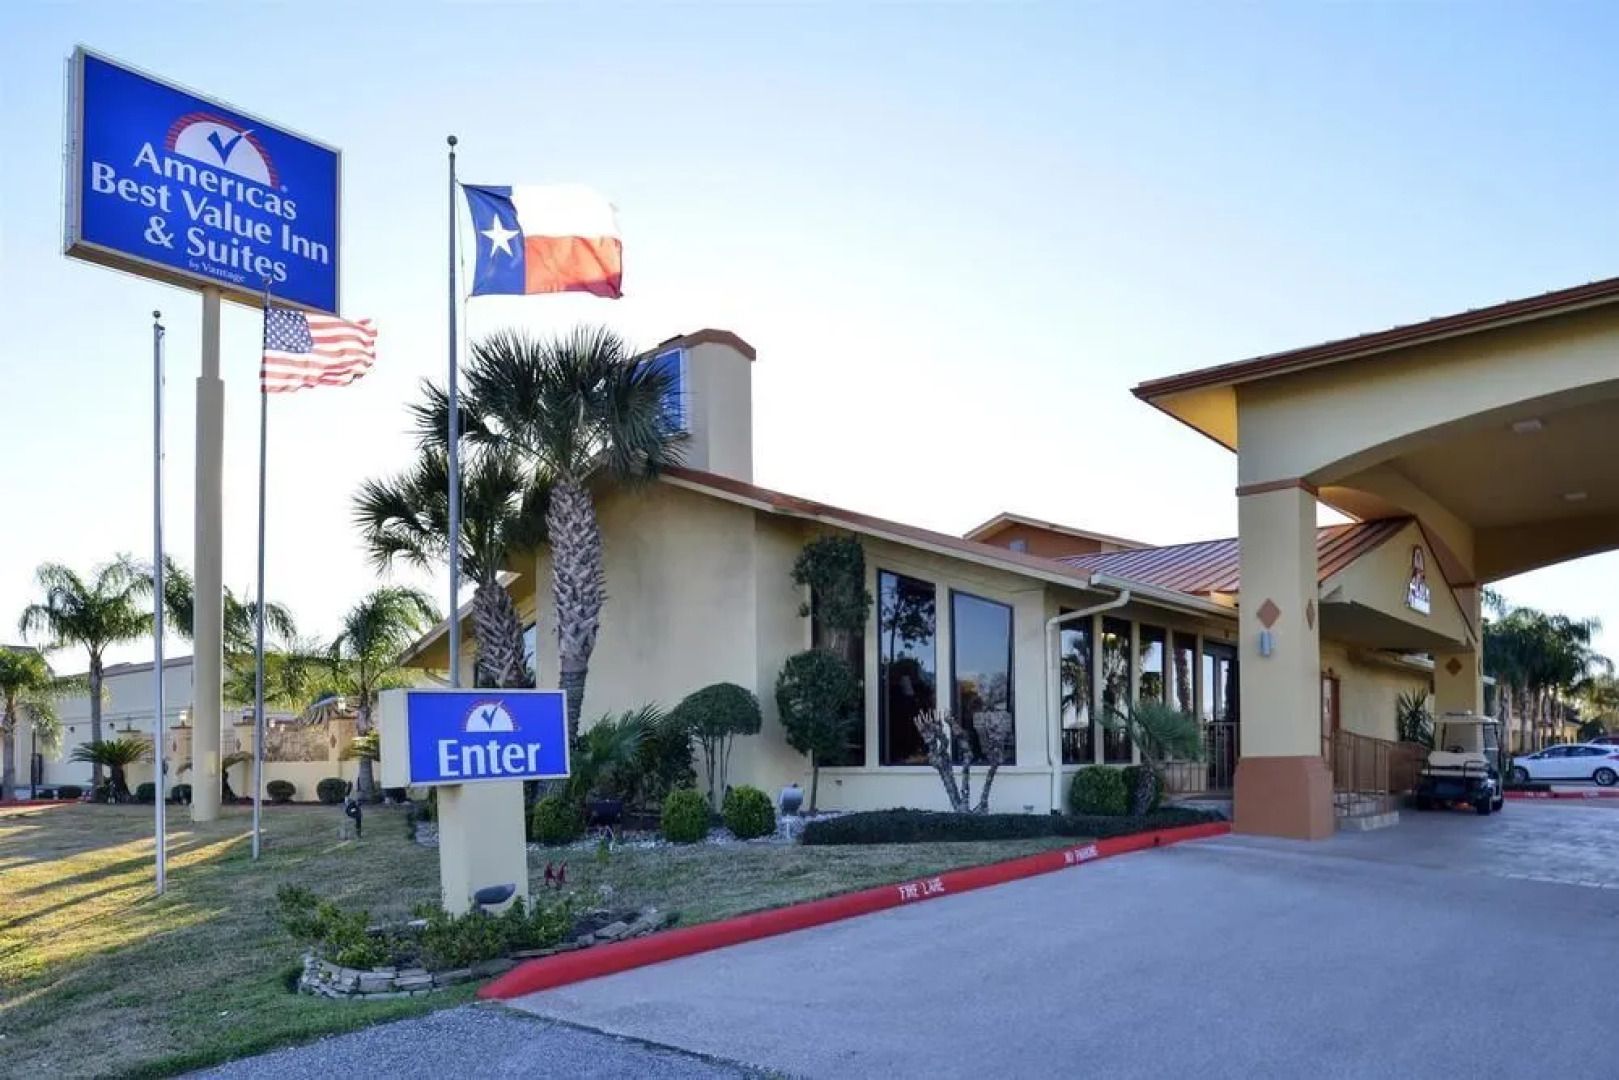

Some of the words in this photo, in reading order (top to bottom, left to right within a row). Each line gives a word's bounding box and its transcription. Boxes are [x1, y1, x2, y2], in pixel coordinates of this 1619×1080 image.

[91, 161, 172, 214] Best
[181, 189, 273, 244] Value
[281, 224, 329, 265] Inn
[133, 142, 298, 221] Americas
[143, 216, 175, 250] &
[187, 226, 287, 283] Suites
[438, 739, 542, 776] Enter
